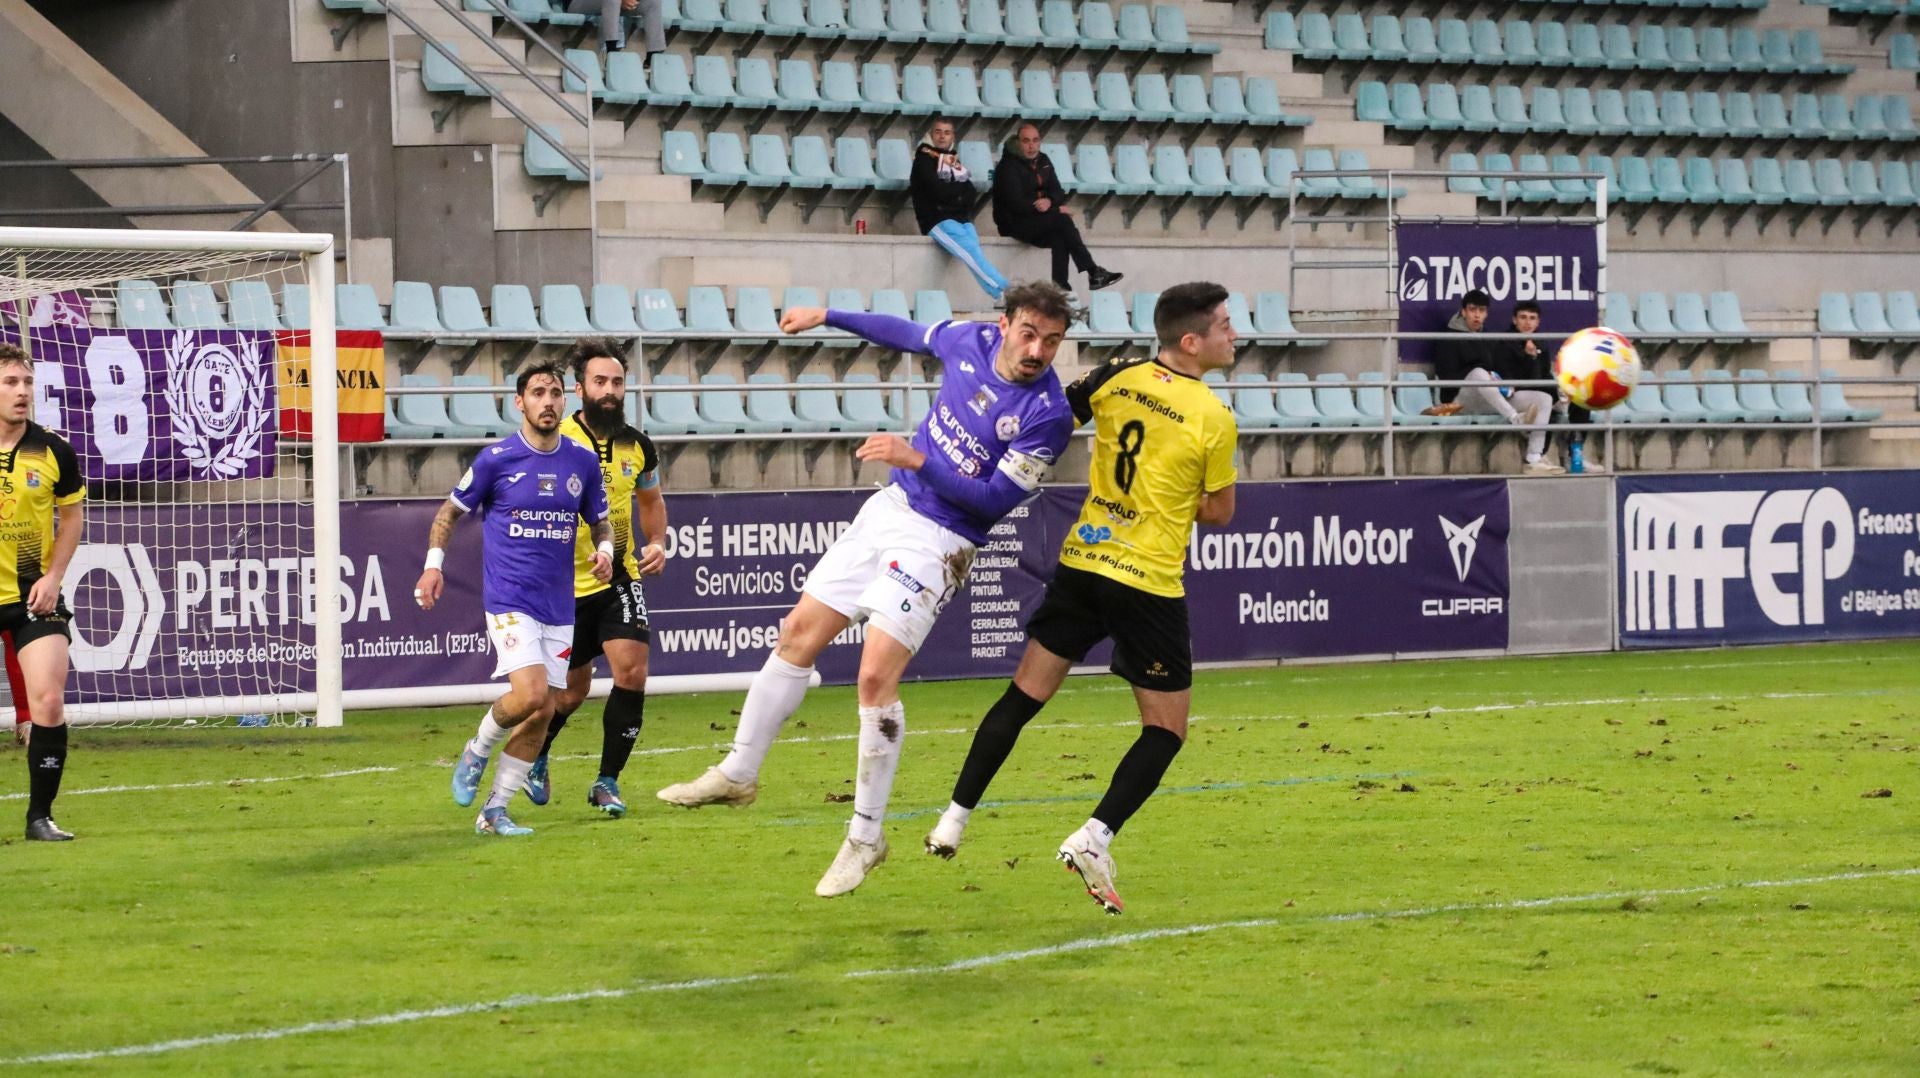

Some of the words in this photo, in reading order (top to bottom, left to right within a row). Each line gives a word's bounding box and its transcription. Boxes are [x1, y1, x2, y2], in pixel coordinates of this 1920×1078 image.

[1429, 255, 1511, 301] TACO
[1514, 255, 1590, 301] BELL
[286, 367, 381, 389] ANCIA
[85, 335, 149, 465] 8
[1135, 392, 1185, 424] Mojados
[928, 411, 976, 475] Danisa
[941, 405, 991, 461] euronics
[1114, 419, 1145, 496] 8
[520, 509, 576, 522] euronics
[987, 521, 1017, 535] ANERÍA
[509, 523, 571, 540] Danisa
[664, 517, 713, 559] OSÉ
[1189, 516, 1305, 571] lanzón
[1312, 515, 1413, 567] Motor
[971, 571, 1001, 583] PLADUR
[1085, 551, 1097, 560] de
[1099, 554, 1146, 578] Mojados
[695, 563, 784, 597] Servicios
[971, 585, 1004, 597] PINTURA
[901, 597, 912, 613] 6
[971, 598, 1020, 613] DECORACIÓN
[1238, 589, 1329, 625] Palencia
[1421, 597, 1503, 617] CUPRA
[1855, 589, 1902, 616] Bélgica
[971, 614, 1018, 630] CERRAJERÍA
[972, 631, 1025, 645] ELECTRICIDAD
[178, 644, 244, 671] Equipos
[246, 642, 266, 663] de
[269, 641, 356, 662] Protecn
[357, 634, 443, 658] Individual.
[971, 645, 1007, 659] PARQUET
